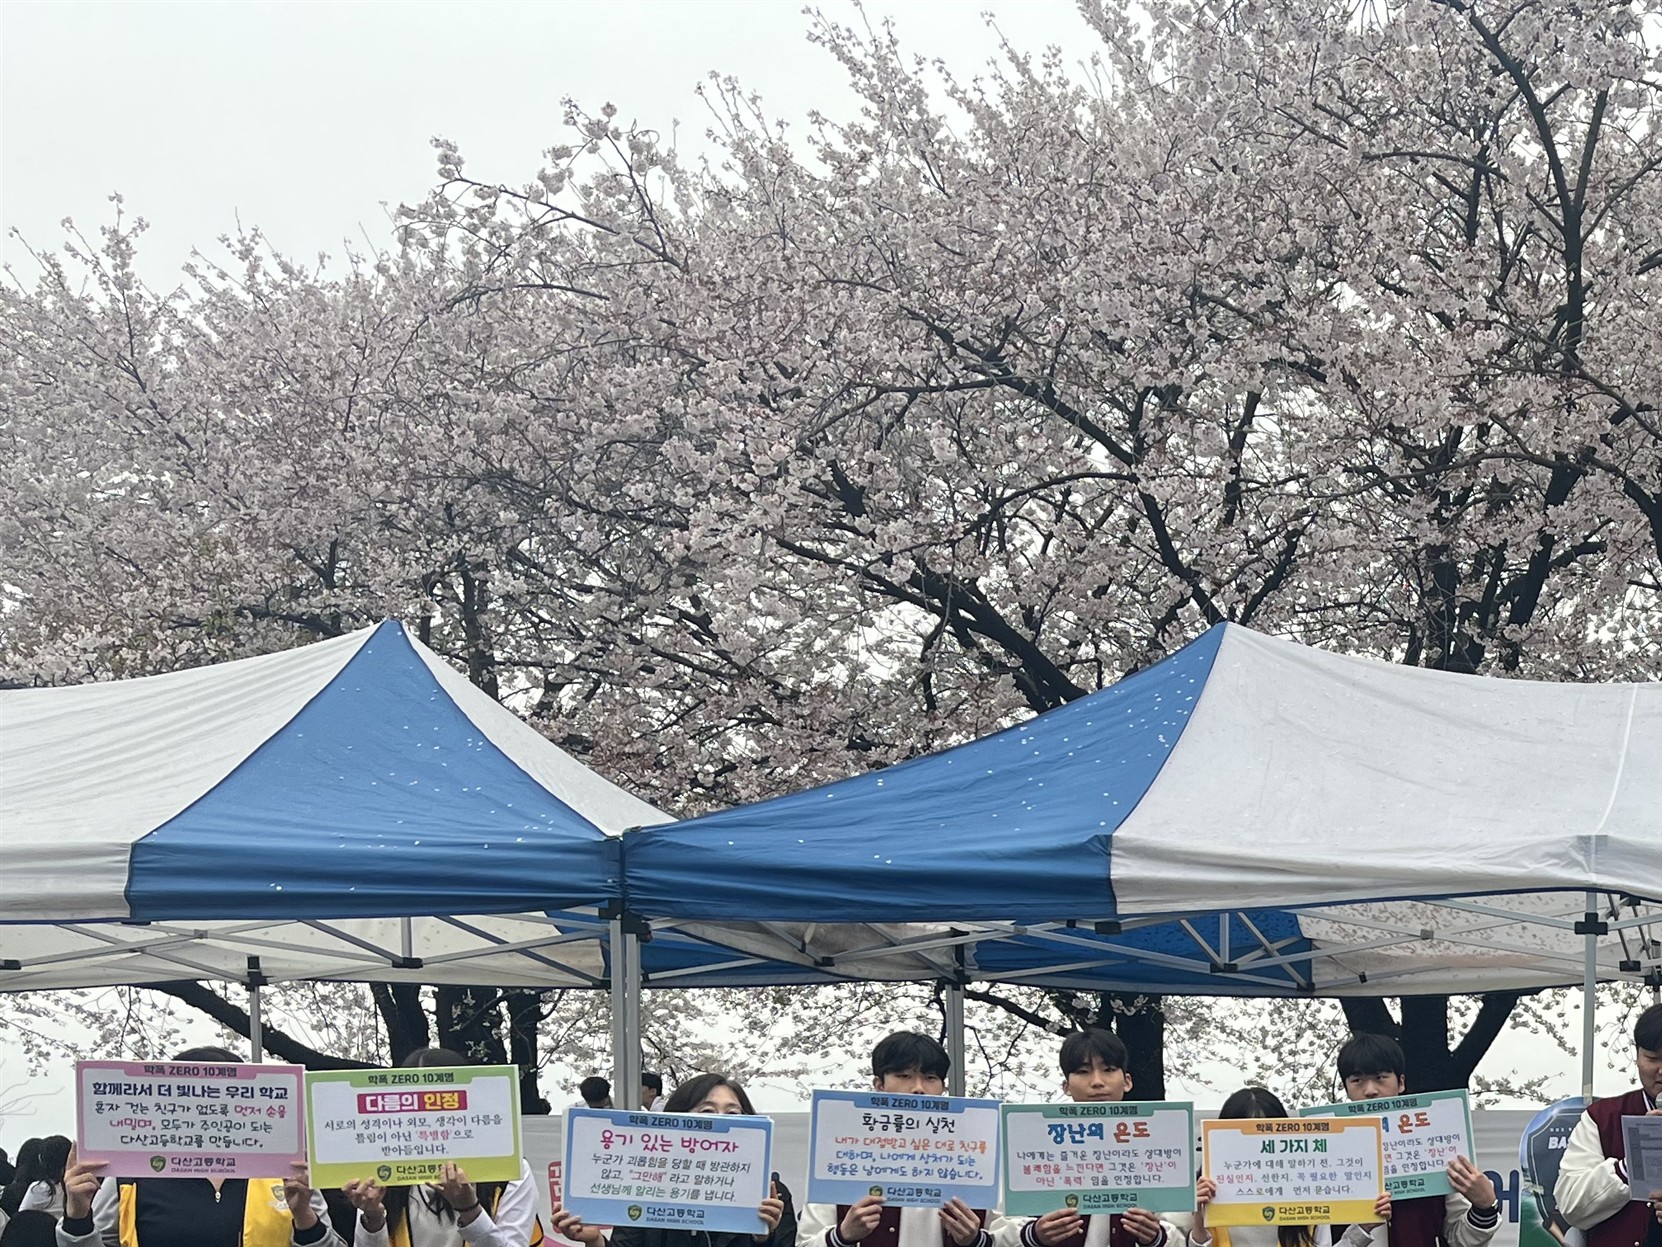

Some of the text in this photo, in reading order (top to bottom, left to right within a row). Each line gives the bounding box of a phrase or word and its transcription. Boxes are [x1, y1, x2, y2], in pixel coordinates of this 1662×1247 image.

[169, 1066, 200, 1076] ZERO
[204, 1067, 237, 1077] 10계명
[93, 1082, 288, 1100] 함께라서 더 빛나는 우리 학교
[366, 1092, 459, 1111] 다름의 인정
[95, 1102, 286, 1118] 혼자 걷는 친구가 없도록 먼저 손을
[161, 1119, 195, 1130] 모두가
[201, 1120, 245, 1132] 주인공이
[250, 1123, 273, 1133] 되는
[325, 1120, 355, 1130] 서로의
[361, 1119, 403, 1130] 성격이나
[436, 1116, 466, 1126] 생각이
[471, 1114, 502, 1125] 다름을
[652, 1117, 679, 1127] ZERO
[682, 1119, 712, 1130] 10계명
[863, 1113, 955, 1133] 황금률의 실천
[1398, 1112, 1431, 1133] 온도
[355, 1132, 387, 1144] 틀림이
[391, 1132, 412, 1142] 아닌
[1048, 1122, 1150, 1144] 장난의 온도
[121, 1135, 204, 1148] 다산고등학교를
[601, 1130, 739, 1153] 용기 있는 방어자
[864, 1137, 907, 1148] 대접받고
[911, 1139, 930, 1150] 싶은
[935, 1141, 955, 1151] 대로
[959, 1141, 987, 1154] 친구를
[1260, 1139, 1327, 1154] 세 가지 체
[171, 1157, 235, 1167] 다산고등학교
[880, 1152, 915, 1162] 나에게
[920, 1153, 953, 1164] 상처가
[957, 1156, 975, 1166] 되는
[1224, 1157, 1363, 1170] 누군가에 대해 말하기 그것이
[828, 1163, 858, 1175] 행동은
[912, 1168, 933, 1177] 하지
[887, 1187, 941, 1197] 다산고등학교
[1083, 1193, 1137, 1202] 다산고등학교
[646, 1207, 704, 1218] 다산고등학교
[1279, 1206, 1330, 1215] 다산고등학교
